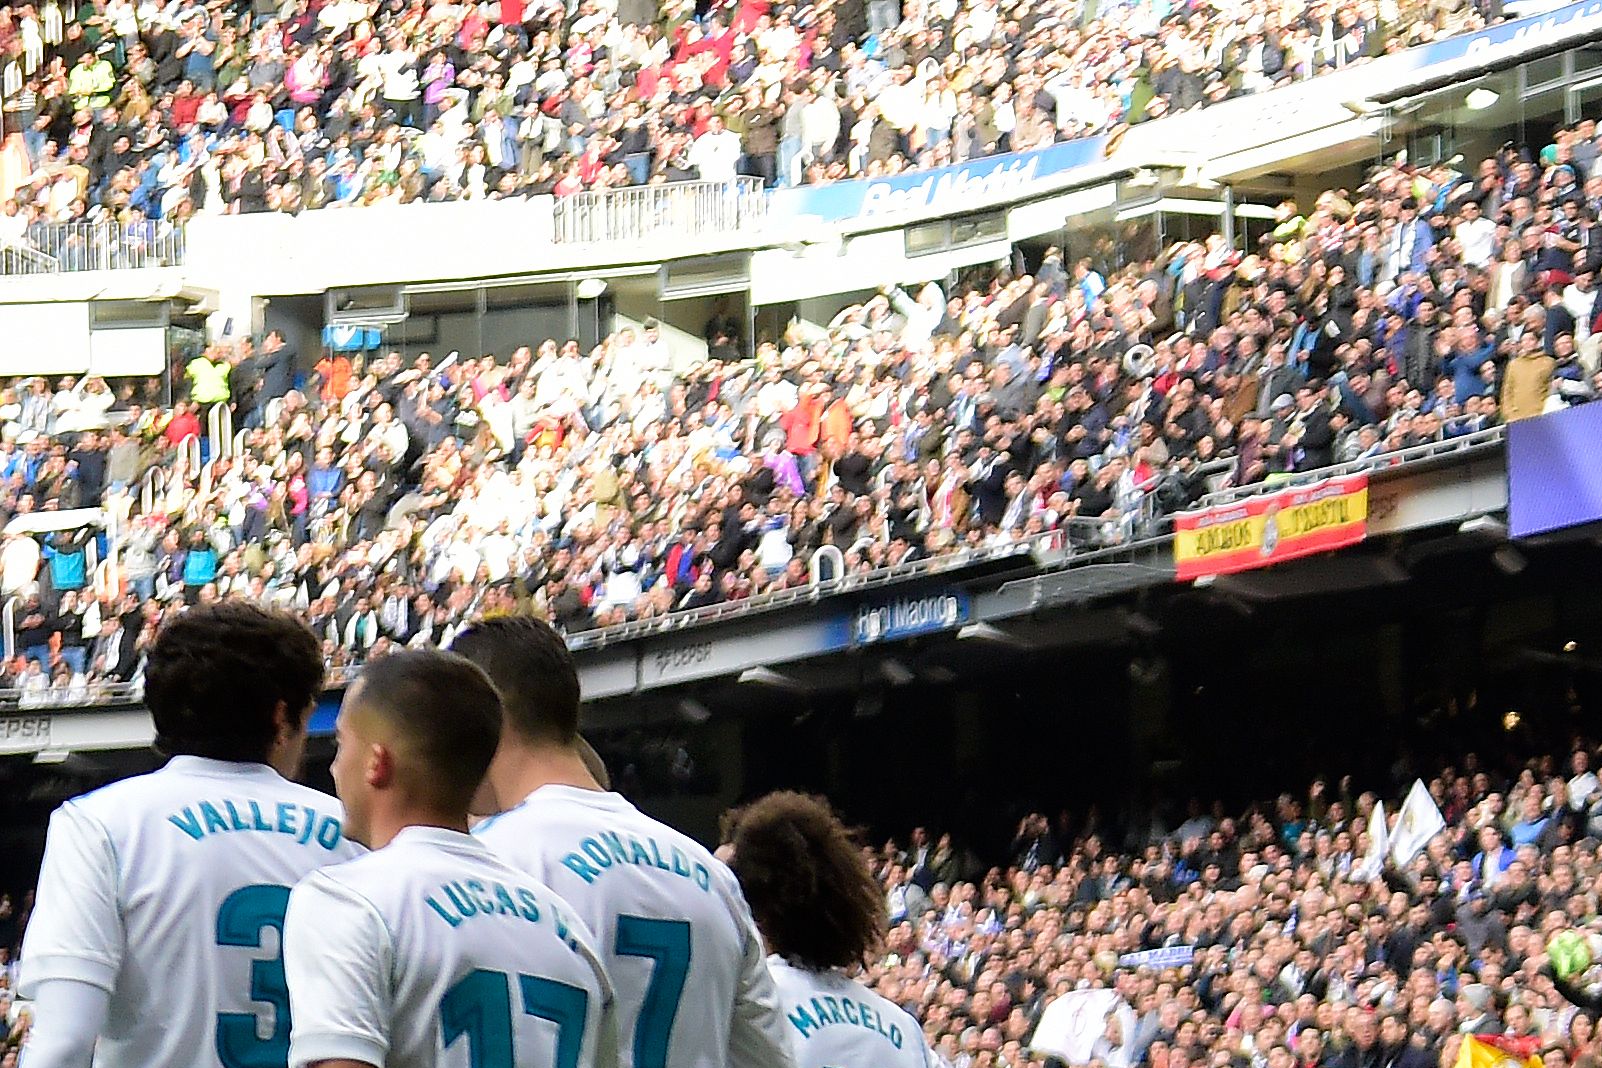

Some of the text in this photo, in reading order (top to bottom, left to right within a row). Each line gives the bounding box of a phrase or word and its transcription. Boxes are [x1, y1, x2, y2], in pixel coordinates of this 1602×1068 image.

[859, 605, 891, 640] Ral
[168, 799, 342, 851] VALLEJO
[560, 831, 712, 892] RONALDO
[426, 880, 540, 928] LUCAS
[787, 996, 904, 1050] MARCELO
